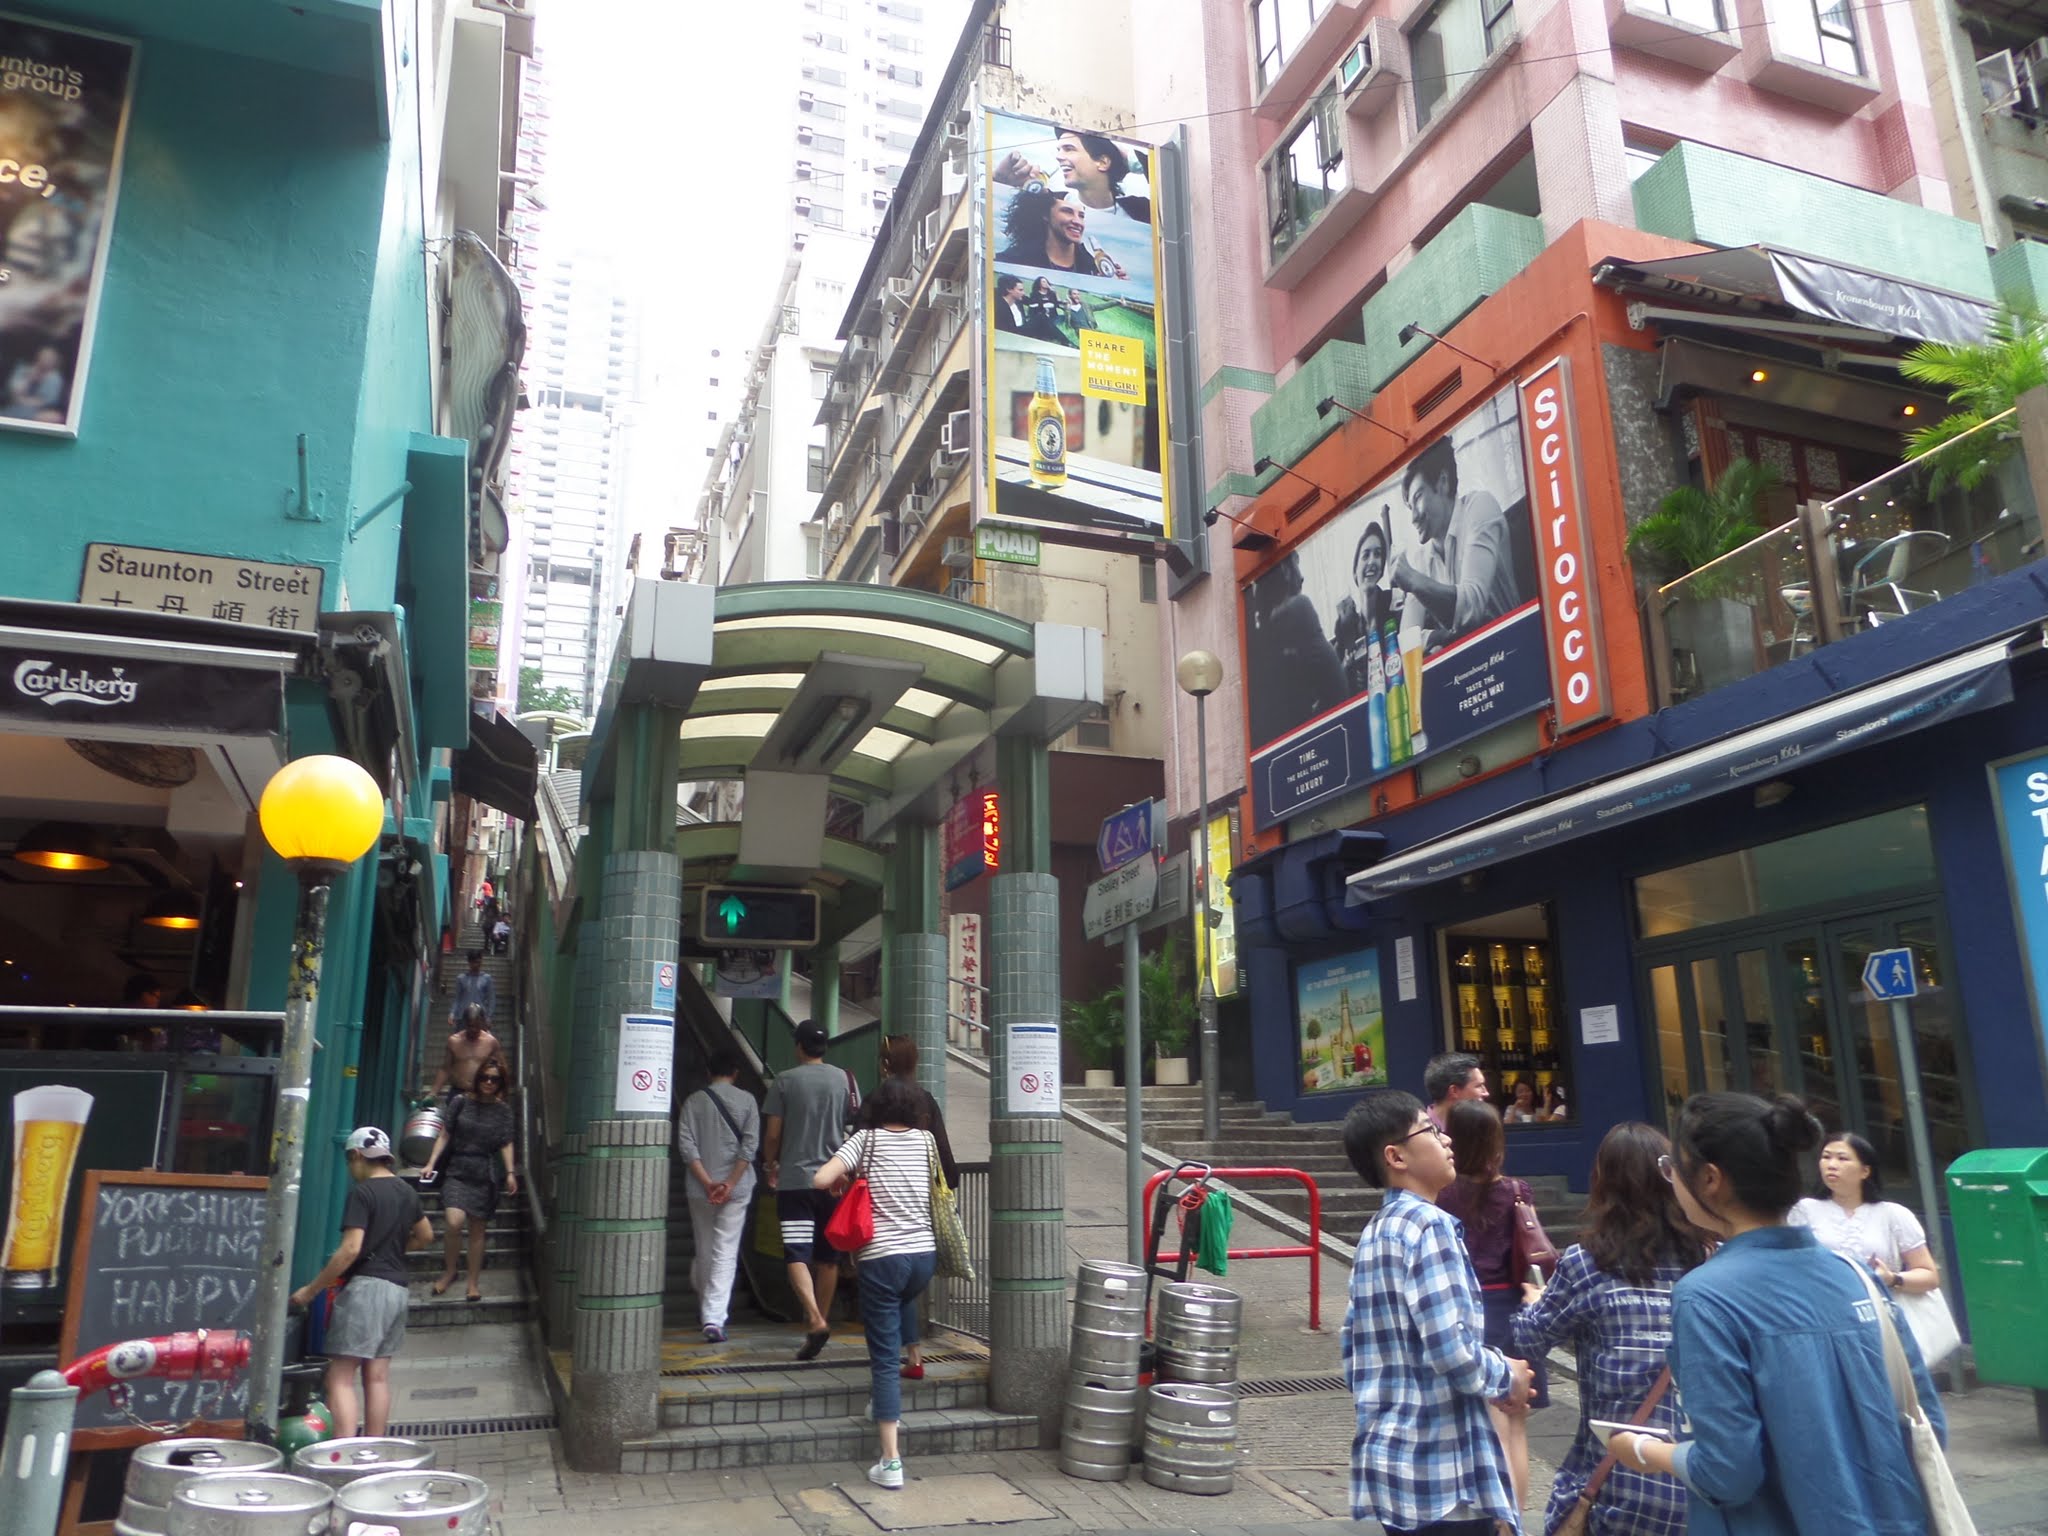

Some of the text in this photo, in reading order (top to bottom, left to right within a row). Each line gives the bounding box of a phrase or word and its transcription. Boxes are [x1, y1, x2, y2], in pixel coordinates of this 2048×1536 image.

[3, 71, 81, 101] group
[1836, 290, 1895, 316] Kronenbourg
[1087, 339, 1126, 353] SHARE
[1088, 350, 1110, 361] THE
[1088, 361, 1138, 377] MOMENT
[1088, 376, 1112, 387] BLUE
[1115, 381, 1138, 391] GIRL
[979, 528, 1038, 557] POAD
[1534, 388, 1590, 704] Scirocco
[98, 552, 309, 595] Staunton Street
[14, 660, 138, 704] Carlsberg
[1465, 674, 1495, 694] TASTE THE
[1459, 681, 1505, 711] FRENCH WAY
[1472, 701, 1494, 716] OF LIFE
[1836, 716, 1888, 741] Staunton's
[1296, 775, 1323, 795] LUXURY
[1596, 801, 1634, 819] Staunton's
[100, 1188, 267, 1227] YORKSHIRE
[111, 1274, 257, 1329] HAPPY
